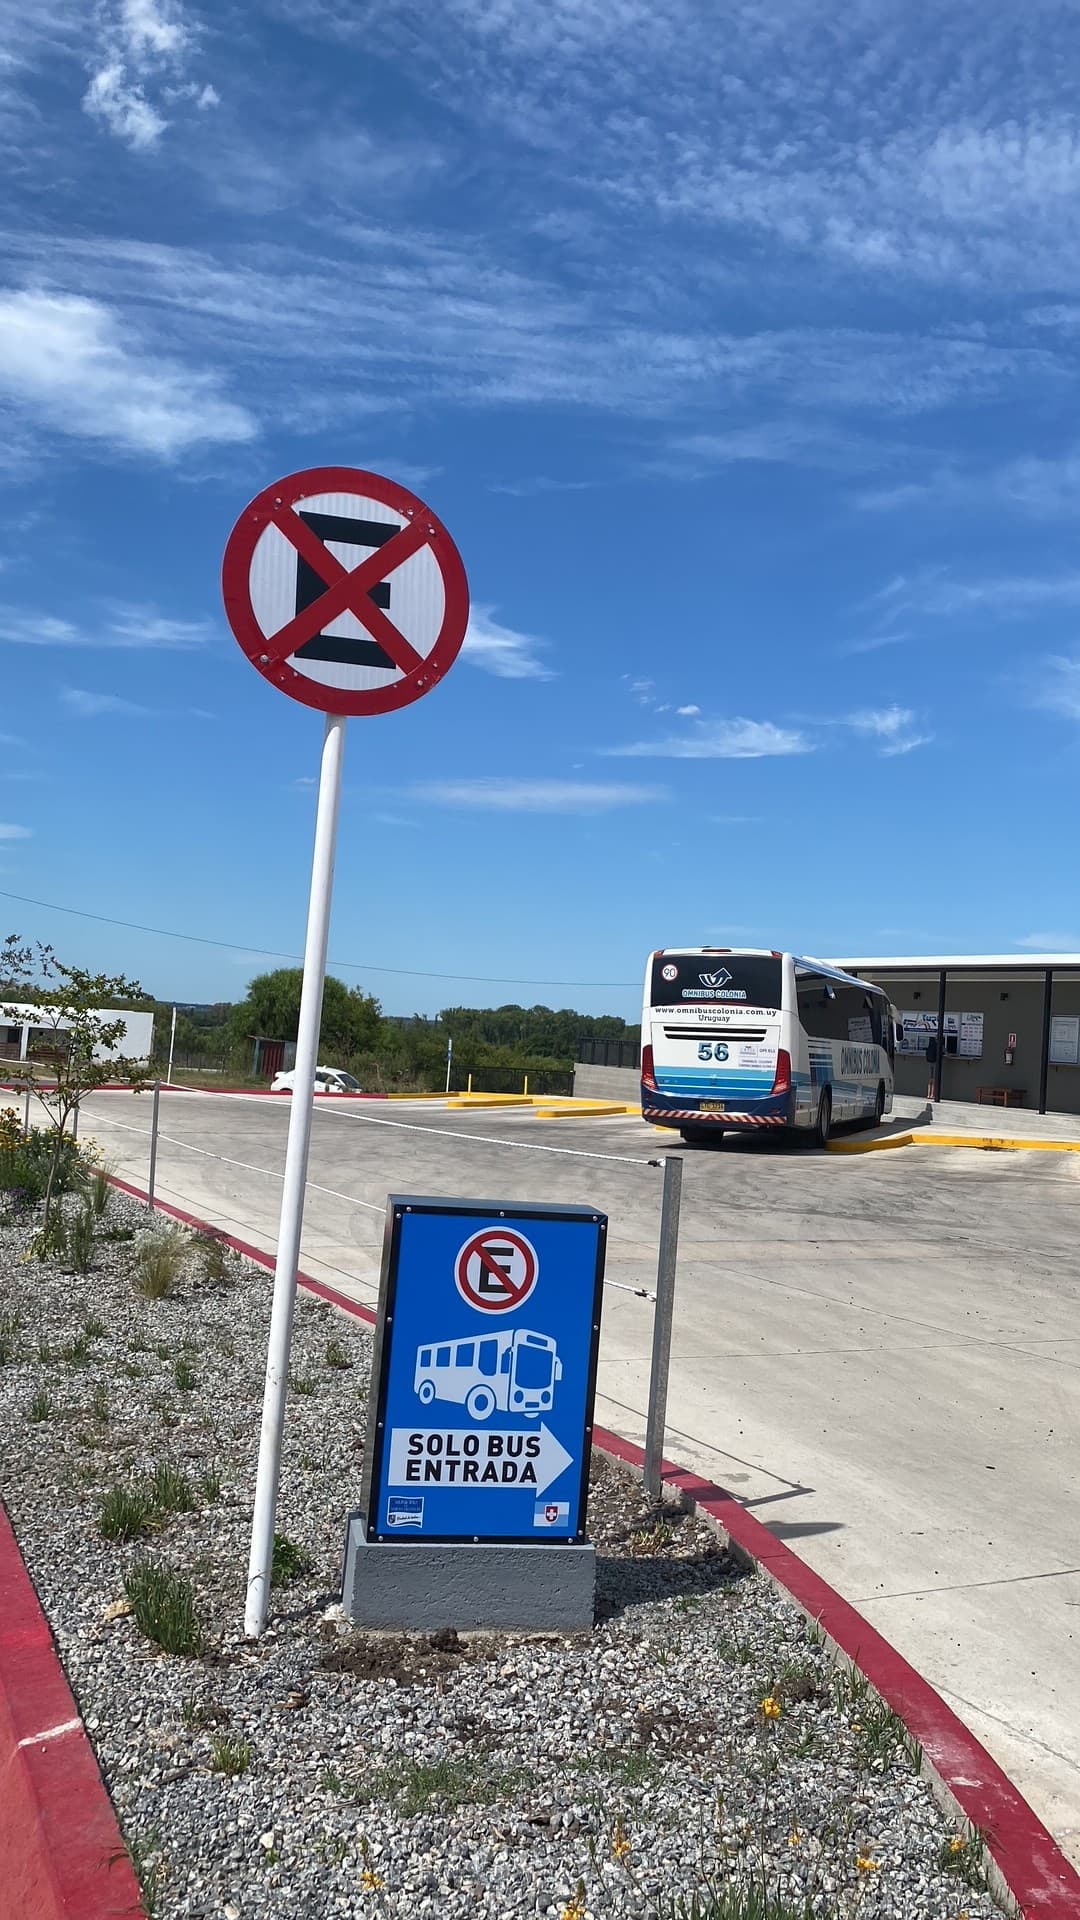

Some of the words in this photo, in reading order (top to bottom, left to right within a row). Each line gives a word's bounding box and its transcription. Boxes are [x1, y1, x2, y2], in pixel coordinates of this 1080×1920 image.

[295, 510, 401, 670] E
[663, 967, 676, 977] 90
[681, 988, 715, 998] OMNIBUS
[715, 989, 747, 999] COLONIA
[655, 1007, 777, 1017] www.omnibuscolonia.com.uy
[698, 1014, 731, 1023] Uruguay
[698, 1042, 730, 1061] 56
[478, 1247, 514, 1293] E
[408, 1433, 480, 1456] SOLO
[487, 1435, 541, 1457] BUS
[406, 1459, 538, 1483] ENTRADA
